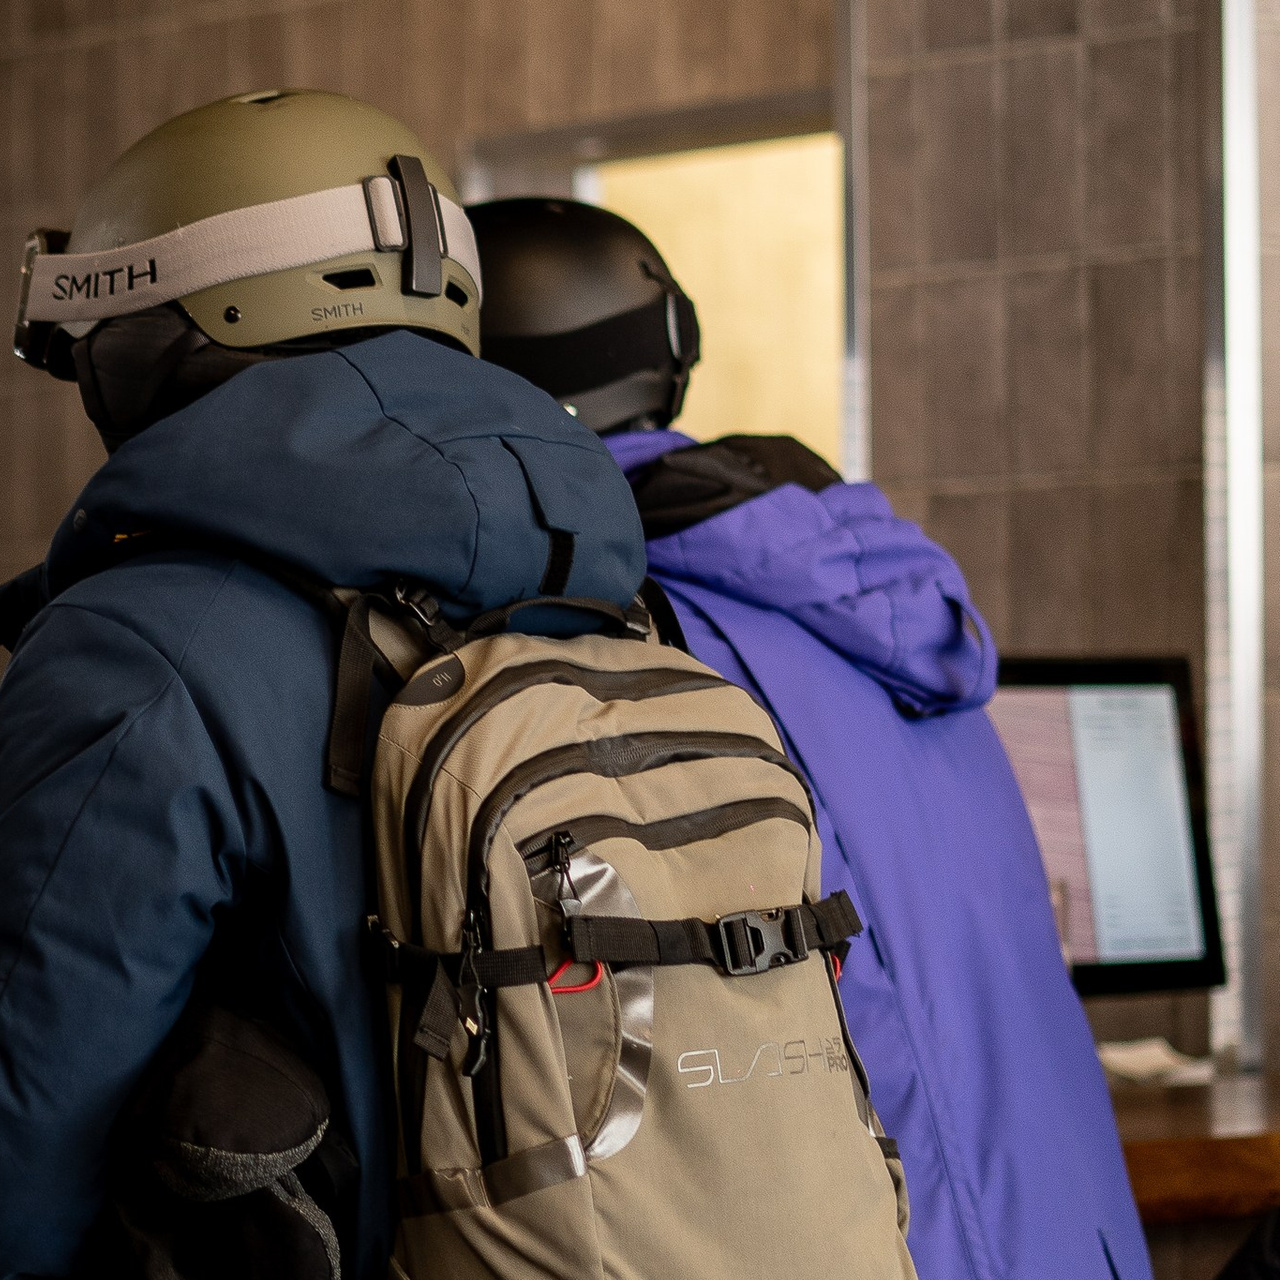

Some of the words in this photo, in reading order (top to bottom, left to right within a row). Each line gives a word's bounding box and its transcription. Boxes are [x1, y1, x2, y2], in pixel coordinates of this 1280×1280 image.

[52, 257, 157, 300] SMITH
[311, 302, 364, 321] SMITH
[677, 1038, 828, 1088] SLASH
